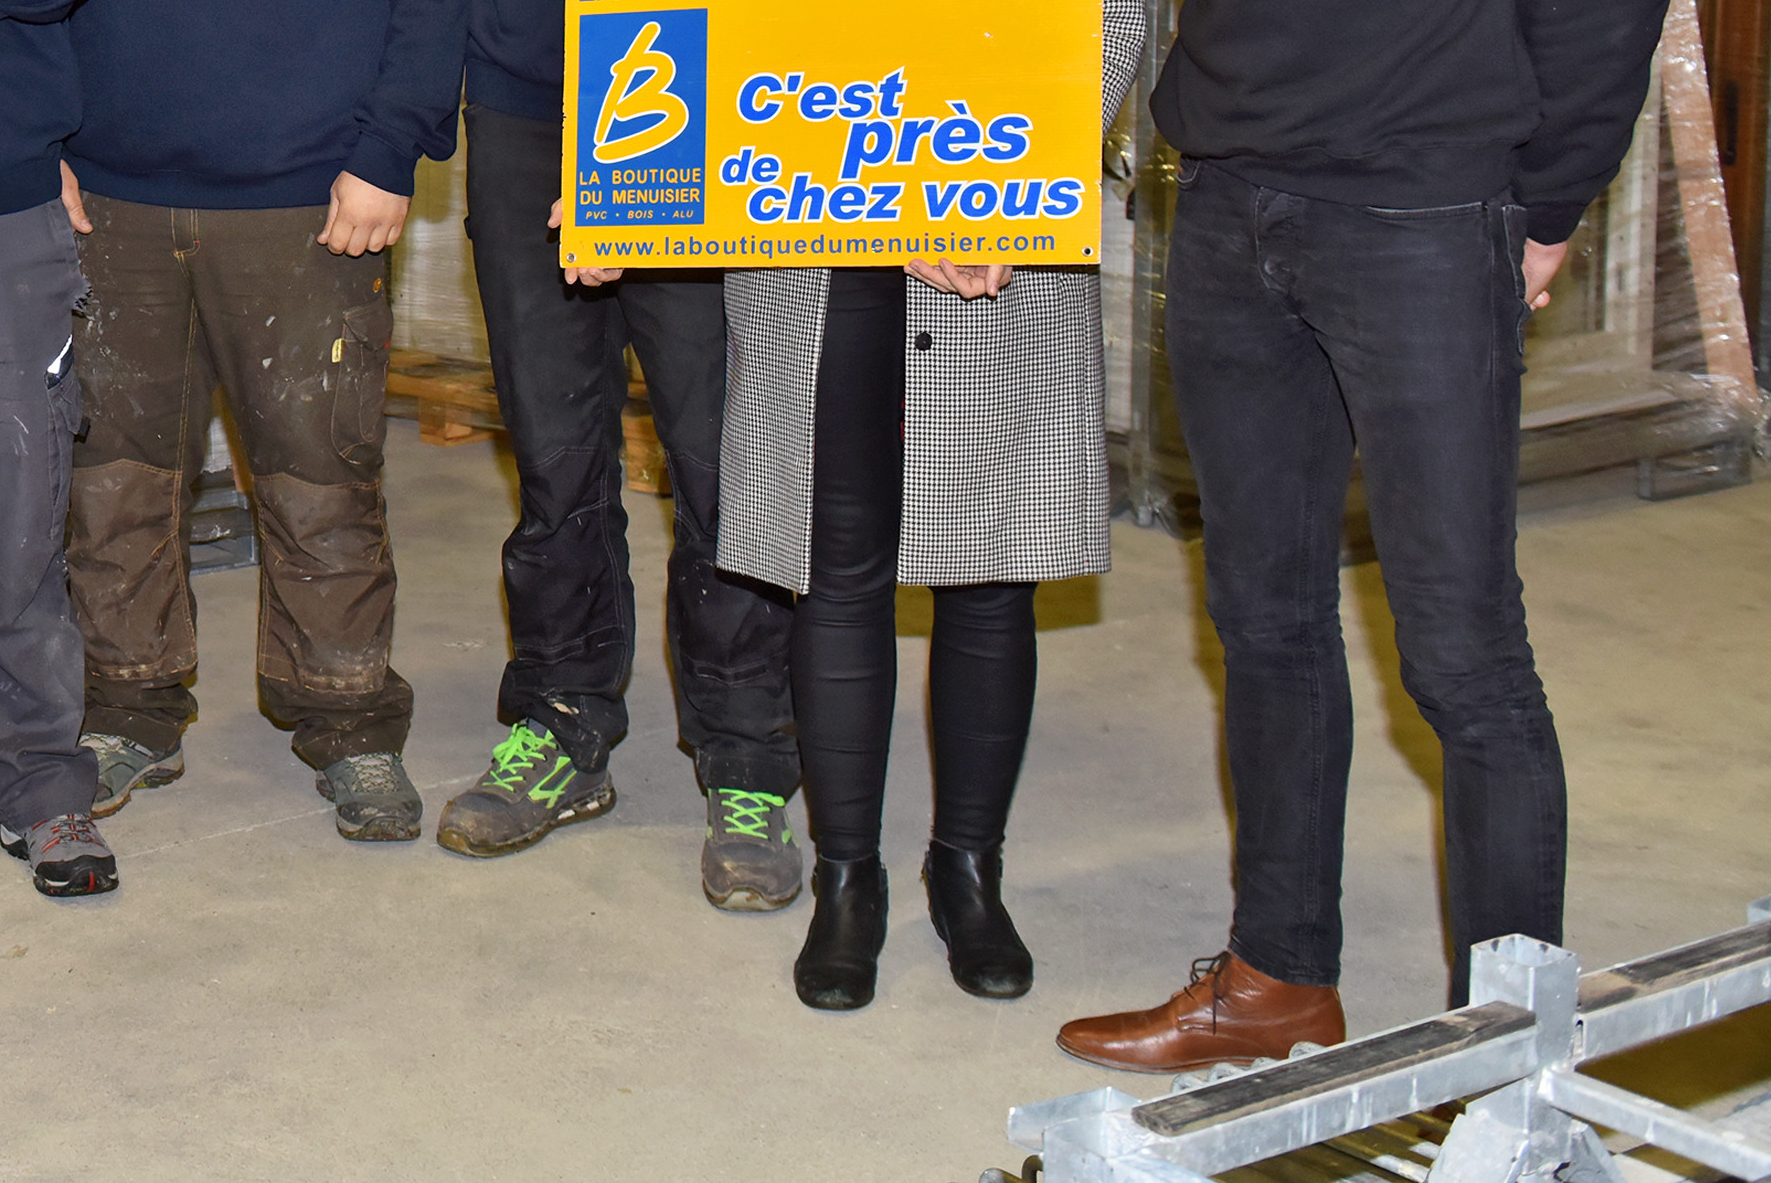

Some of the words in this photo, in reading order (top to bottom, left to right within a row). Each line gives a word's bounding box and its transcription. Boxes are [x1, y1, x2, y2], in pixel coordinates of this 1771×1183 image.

[736, 66, 908, 123] C'est
[838, 100, 1033, 182] près
[579, 170, 601, 185] LA
[612, 168, 702, 185] BOUTIQUE
[719, 146, 782, 186] de
[580, 190, 603, 205] DU
[612, 187, 701, 204] MENUISIER
[746, 172, 905, 224] chez
[922, 177, 1085, 221] vous
[585, 210, 608, 220] PVC
[627, 210, 654, 219] BOIS
[672, 209, 694, 218] ALU
[594, 232, 1056, 259] www.laboutiquedumenuisier.com
